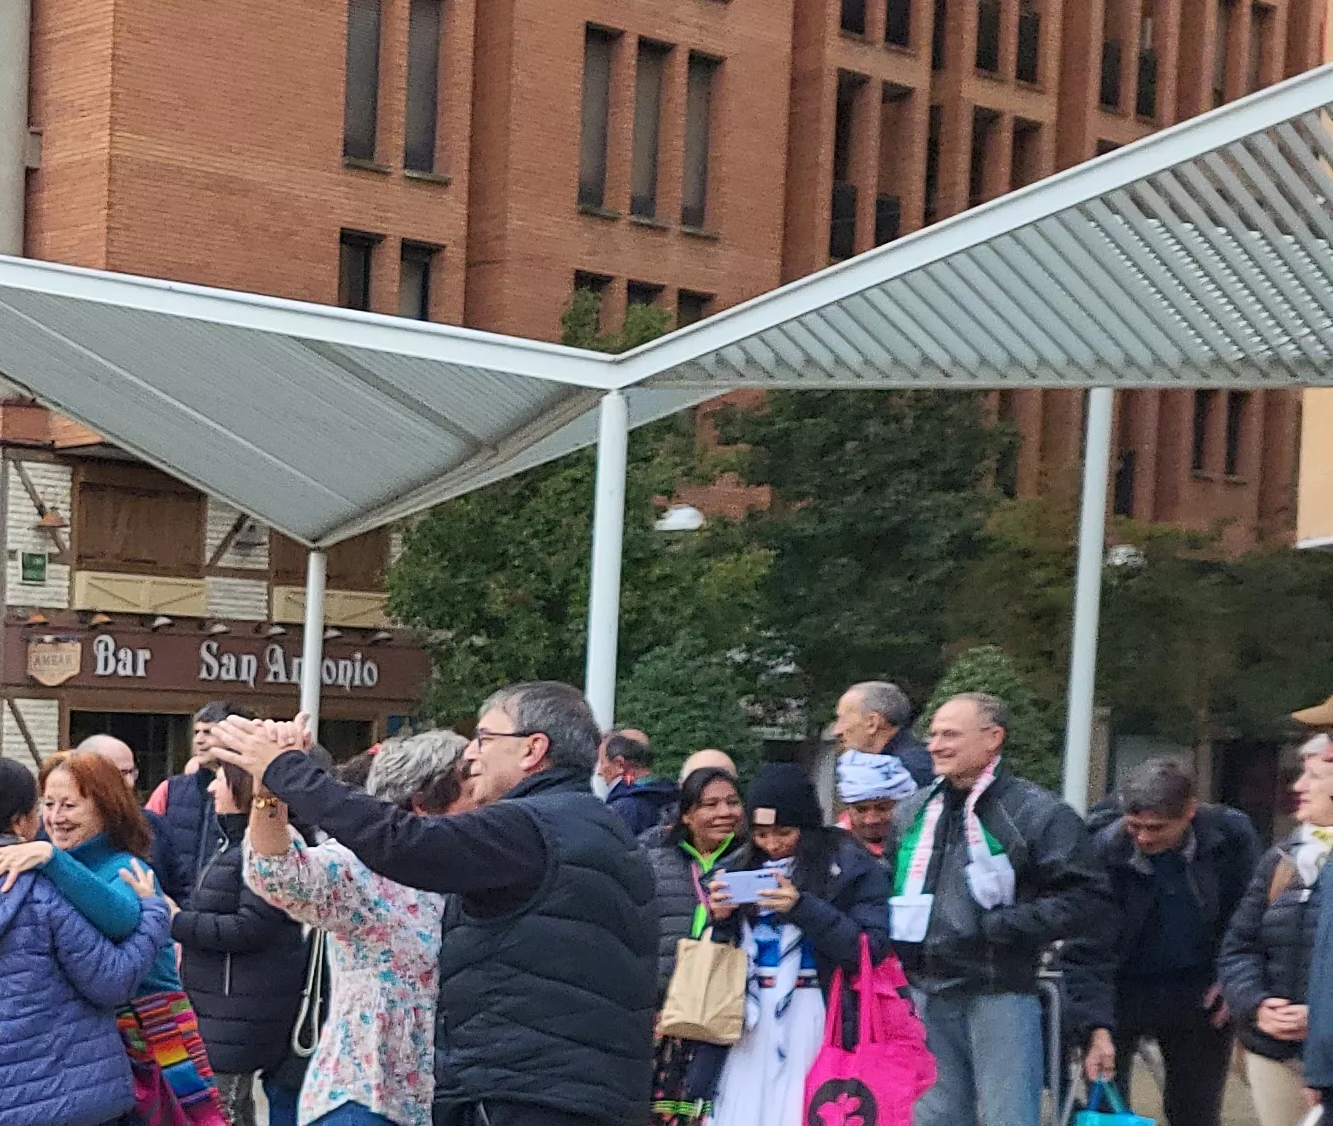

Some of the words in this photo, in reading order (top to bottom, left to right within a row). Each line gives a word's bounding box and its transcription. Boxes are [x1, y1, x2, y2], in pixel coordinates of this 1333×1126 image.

[93, 634, 152, 677] Bar
[198, 640, 257, 689] San
[264, 643, 379, 692] Anonio
